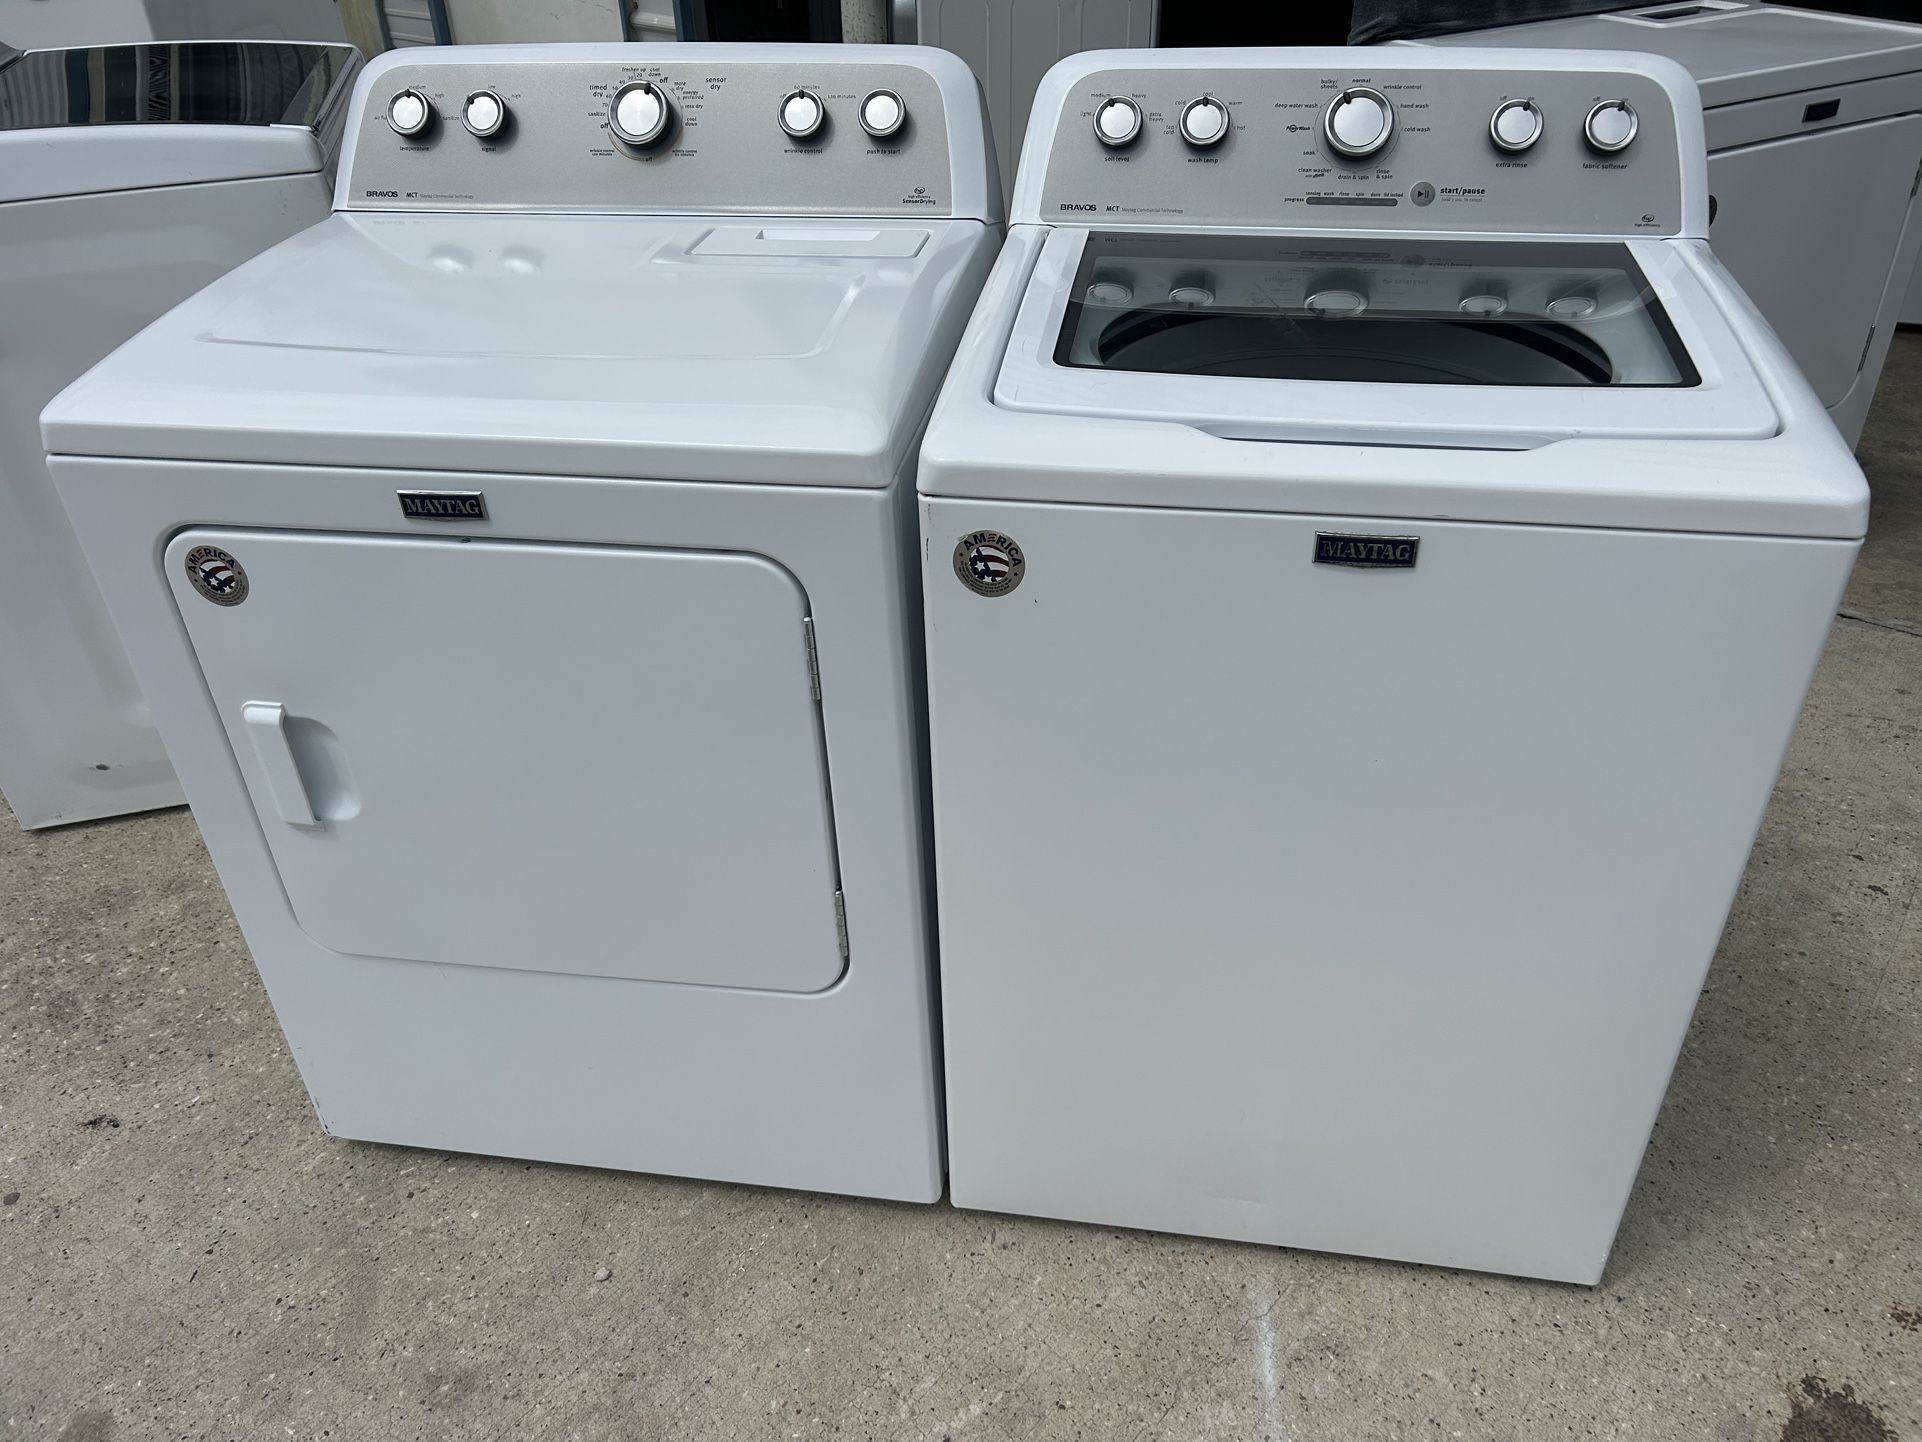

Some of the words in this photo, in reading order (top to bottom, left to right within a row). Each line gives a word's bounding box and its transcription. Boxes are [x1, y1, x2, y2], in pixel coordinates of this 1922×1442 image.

[1440, 187, 1486, 196] start/pause
[404, 499, 480, 514] MAYTAG
[964, 533, 1022, 567] AMERICA
[1321, 541, 1410, 560] MAYTAG
[188, 548, 235, 574] AMERICA
